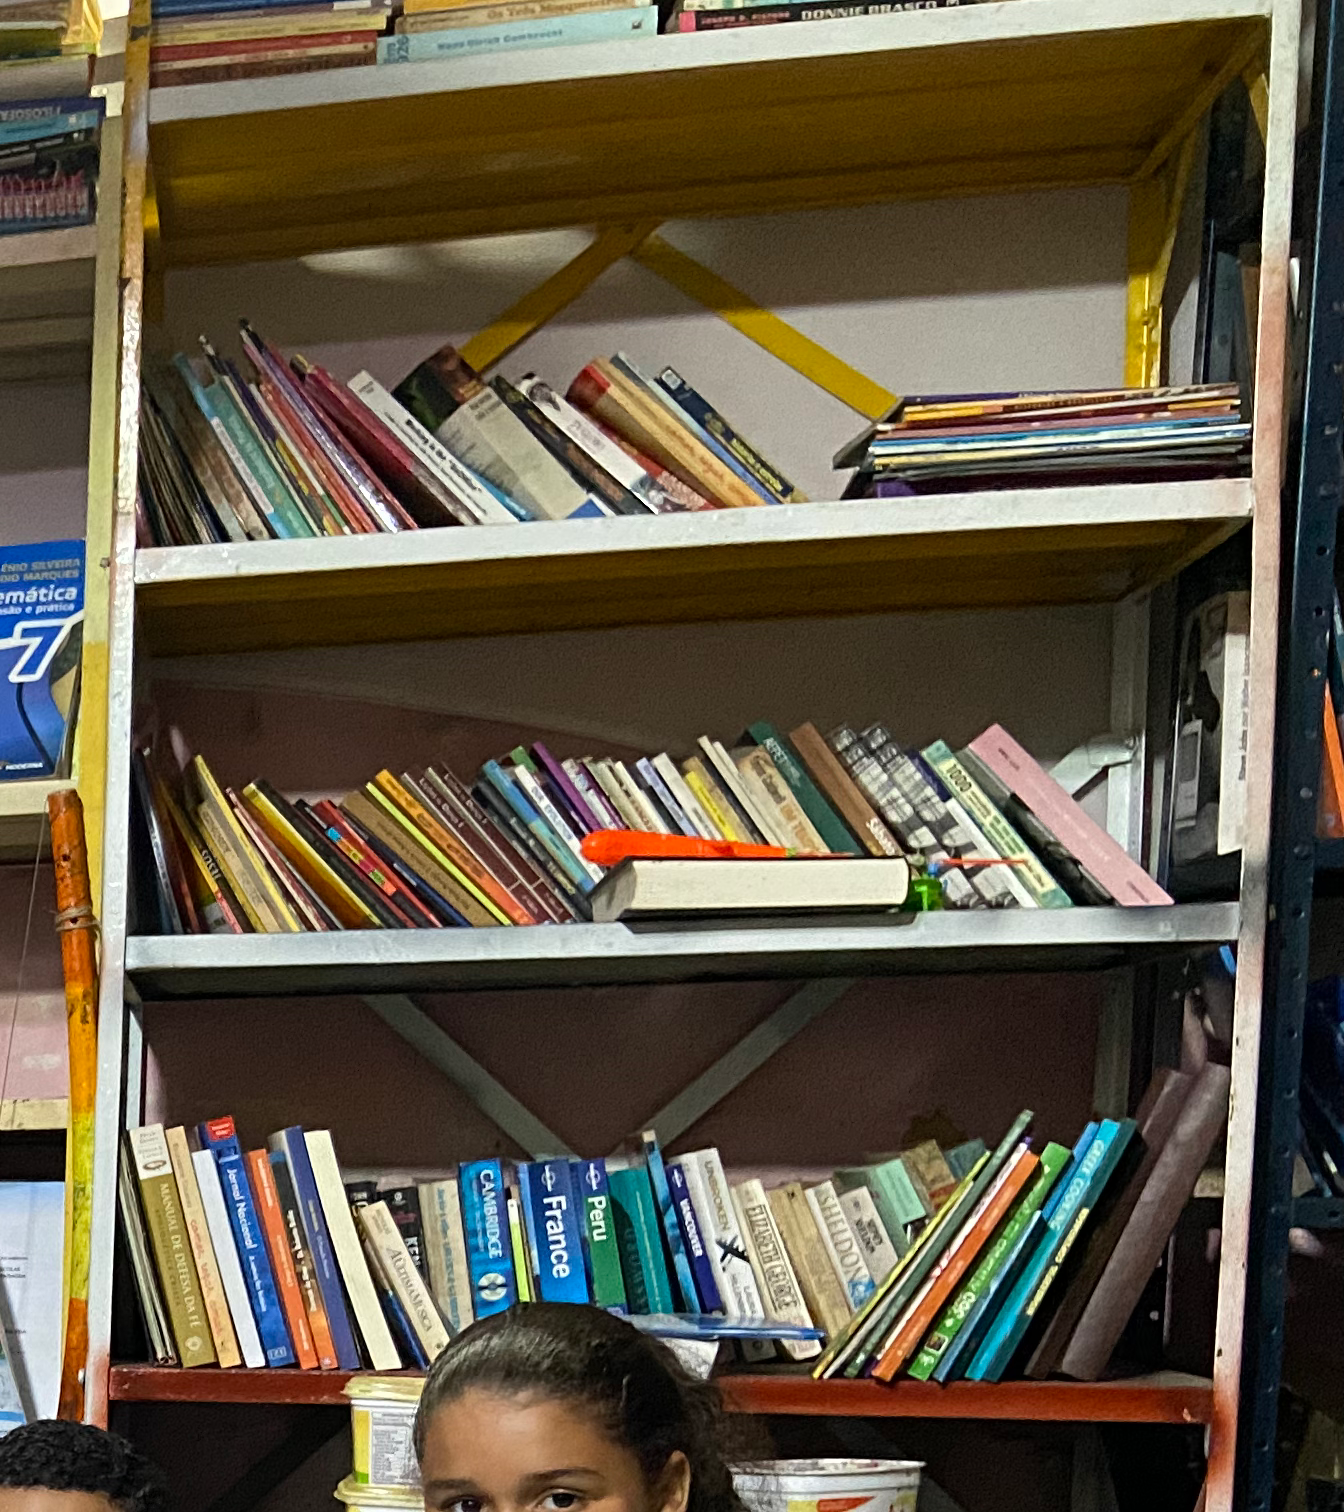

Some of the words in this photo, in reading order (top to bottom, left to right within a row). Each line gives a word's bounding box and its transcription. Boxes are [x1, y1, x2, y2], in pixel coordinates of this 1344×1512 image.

[802, 7, 862, 21] DONNIE
[23, 569, 80, 582] MARQUES
[35, 601, 75, 617] prática
[9, 620, 72, 683] 7
[946, 763, 972, 793] 1000
[226, 1166, 245, 1201] Jornal
[702, 1159, 730, 1231] UNBROKEN
[234, 1200, 257, 1249] Nacional
[478, 1169, 503, 1258] CAMBRIDGE
[587, 1196, 608, 1242] Peru
[542, 1195, 570, 1279] France
